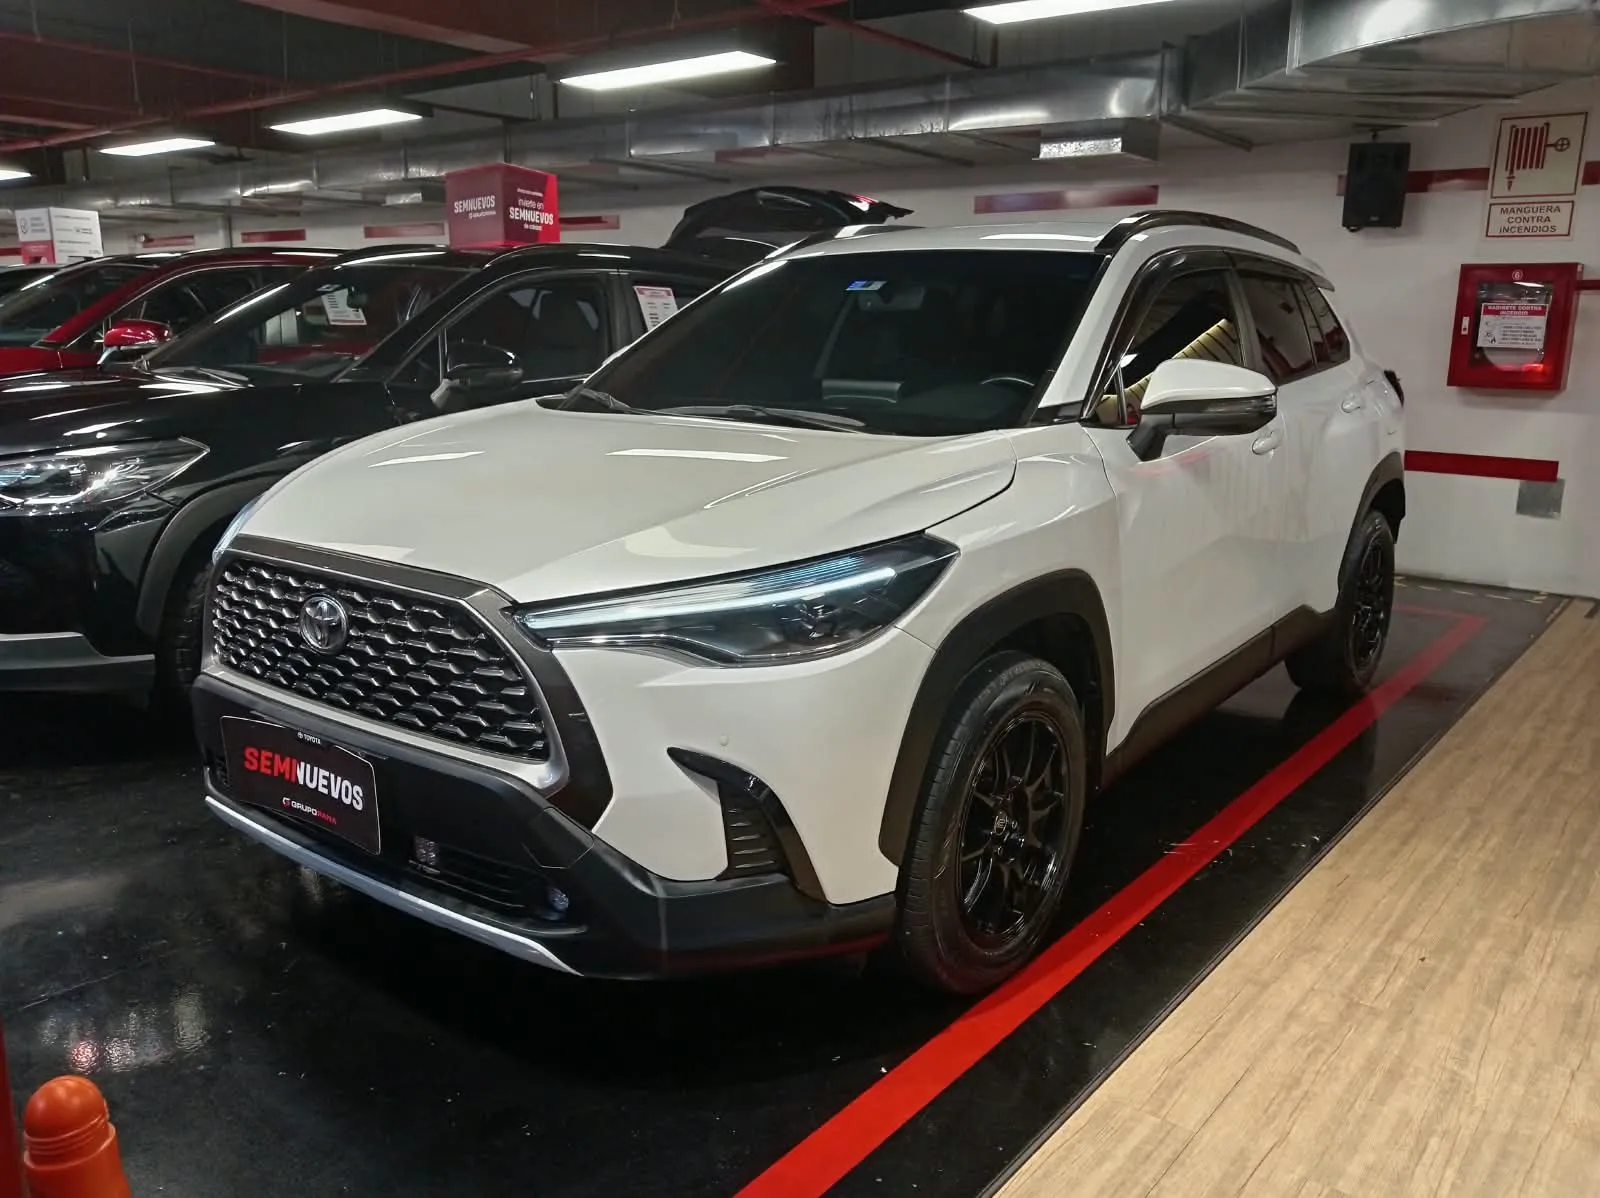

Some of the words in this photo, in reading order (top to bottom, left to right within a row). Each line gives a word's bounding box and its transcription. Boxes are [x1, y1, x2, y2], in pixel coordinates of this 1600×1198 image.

[1500, 205, 1561, 215] MANGUERA
[1507, 215, 1551, 224] CONTRA
[1499, 225, 1557, 234] INCENDIOS
[303, 733, 321, 745] TOYOTA
[243, 746, 364, 811] SEMINUEVOS
